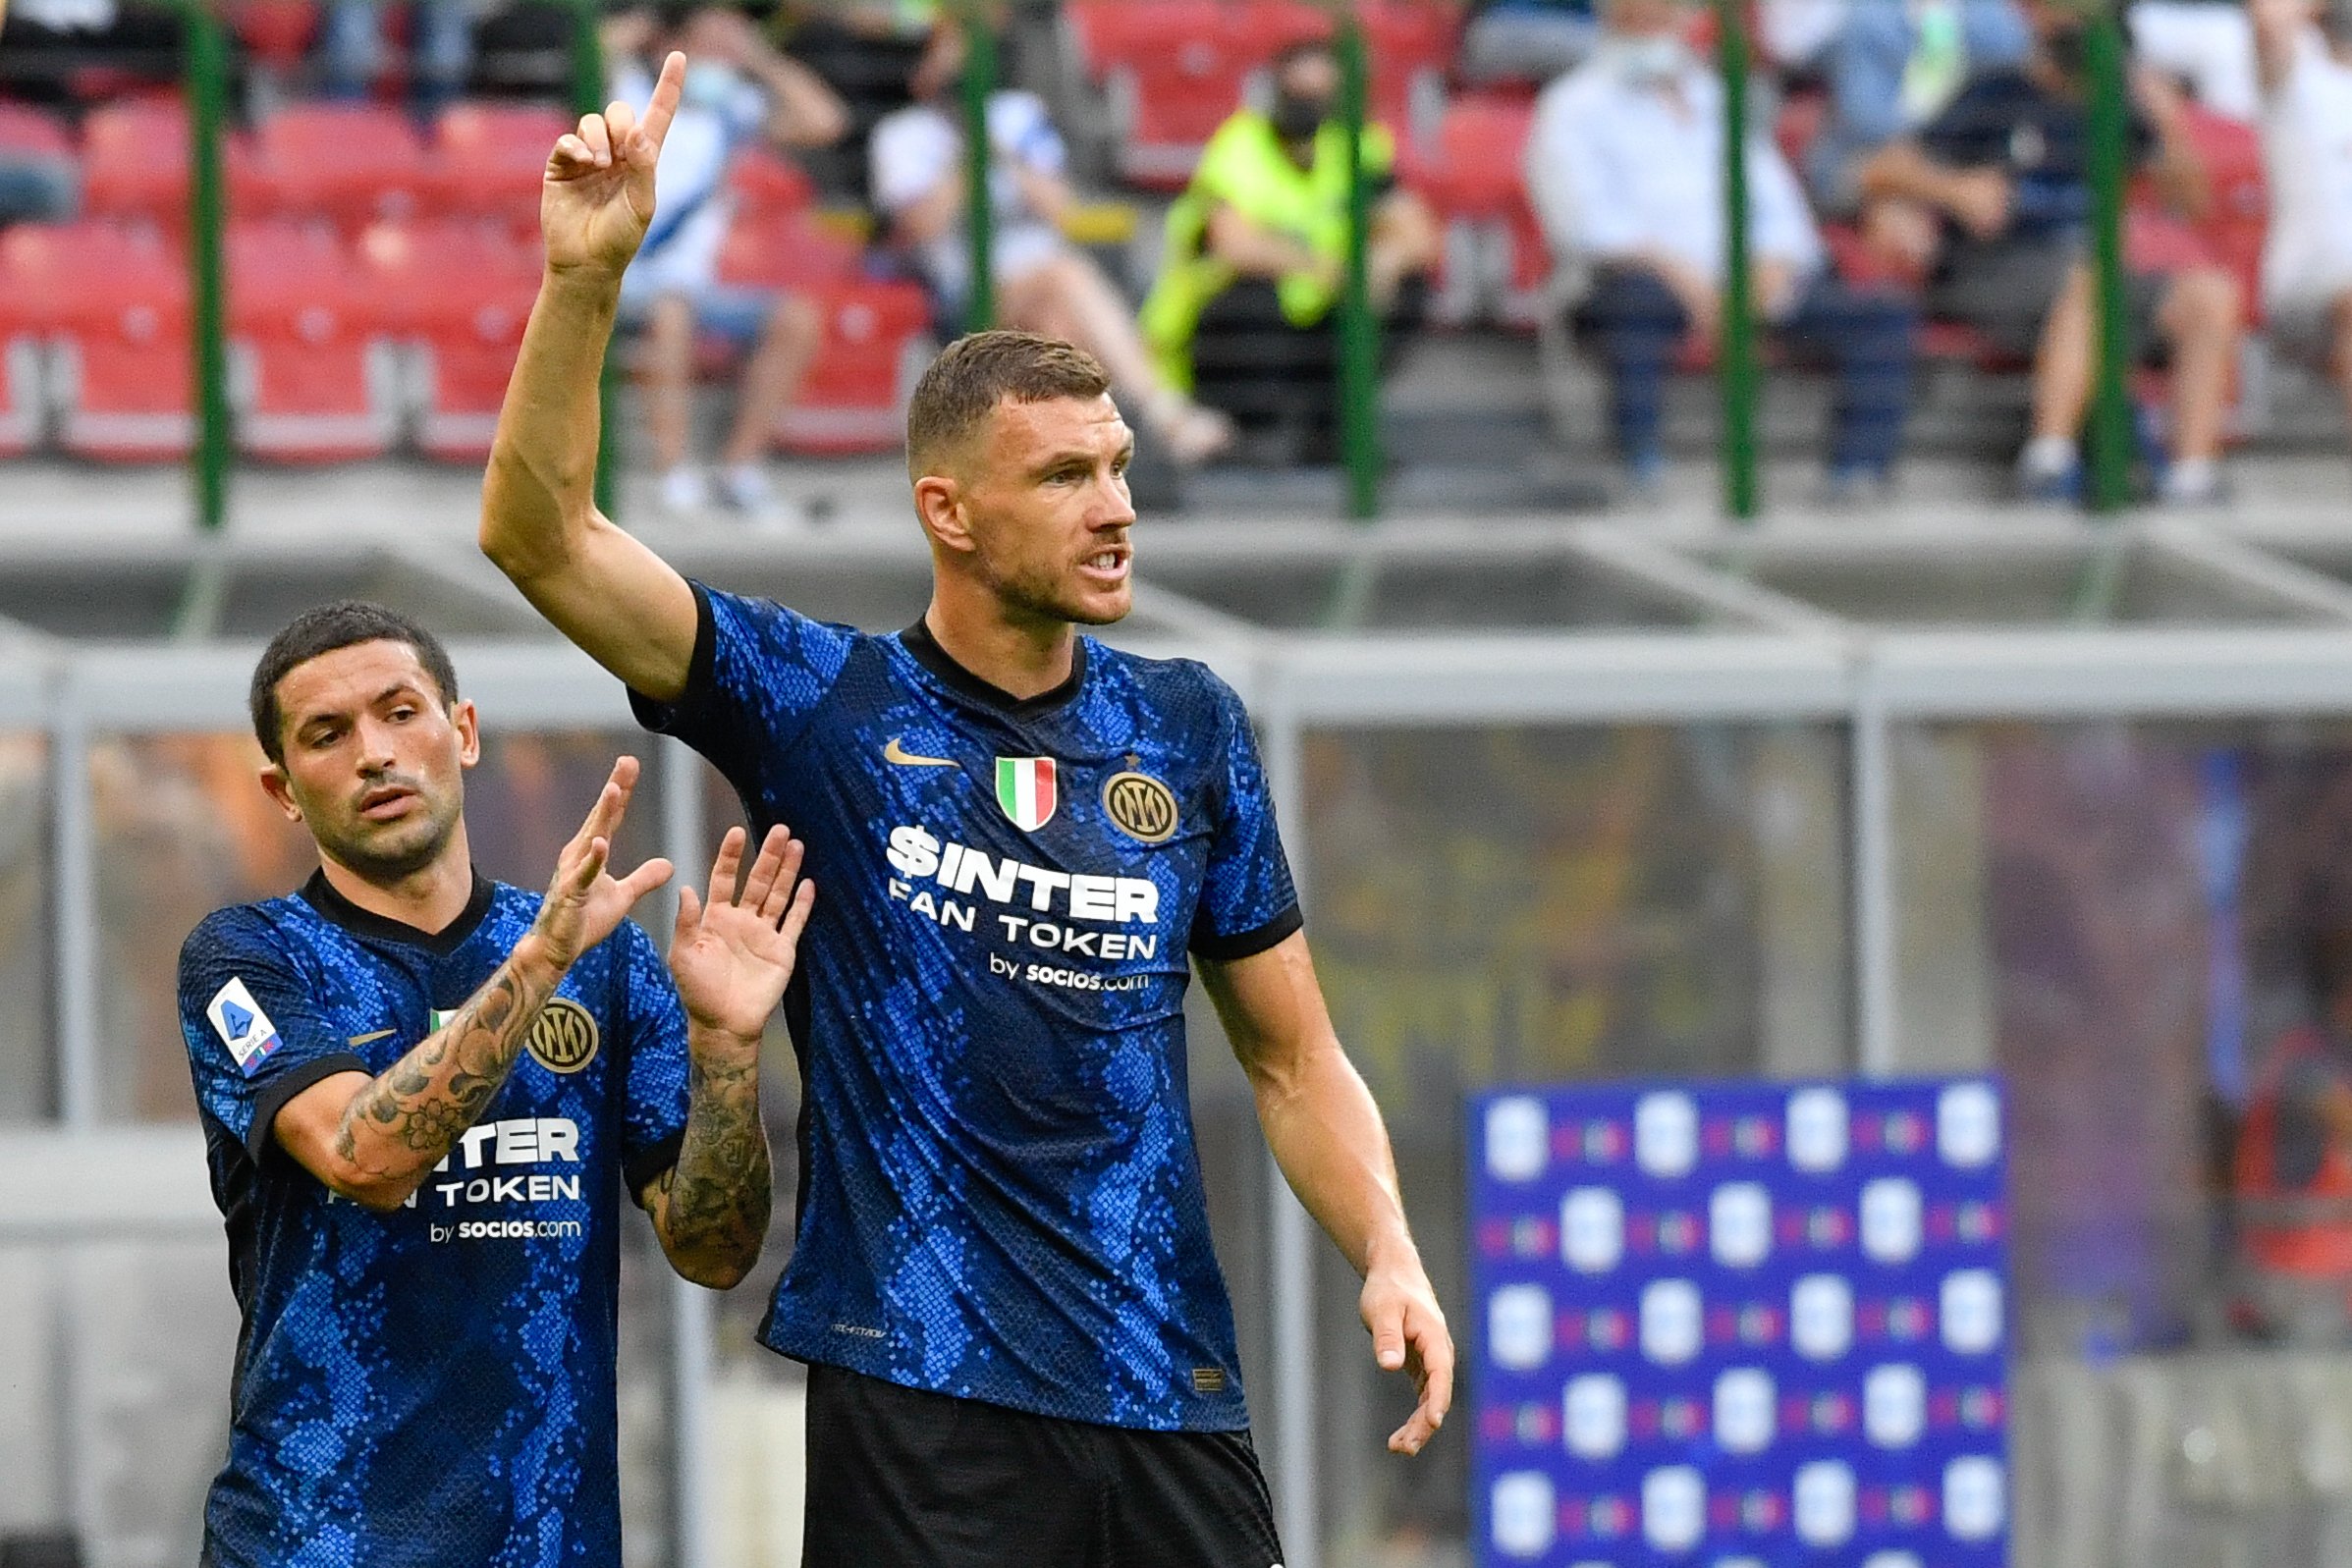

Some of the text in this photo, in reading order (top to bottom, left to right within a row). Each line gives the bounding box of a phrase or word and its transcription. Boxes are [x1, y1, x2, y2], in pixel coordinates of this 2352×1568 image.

[886, 824, 1159, 924] $INTER
[888, 877, 1158, 960] FAN TOKEN
[990, 951, 1020, 981] by
[435, 1174, 580, 1208] TOKEN
[430, 1223, 455, 1244] by
